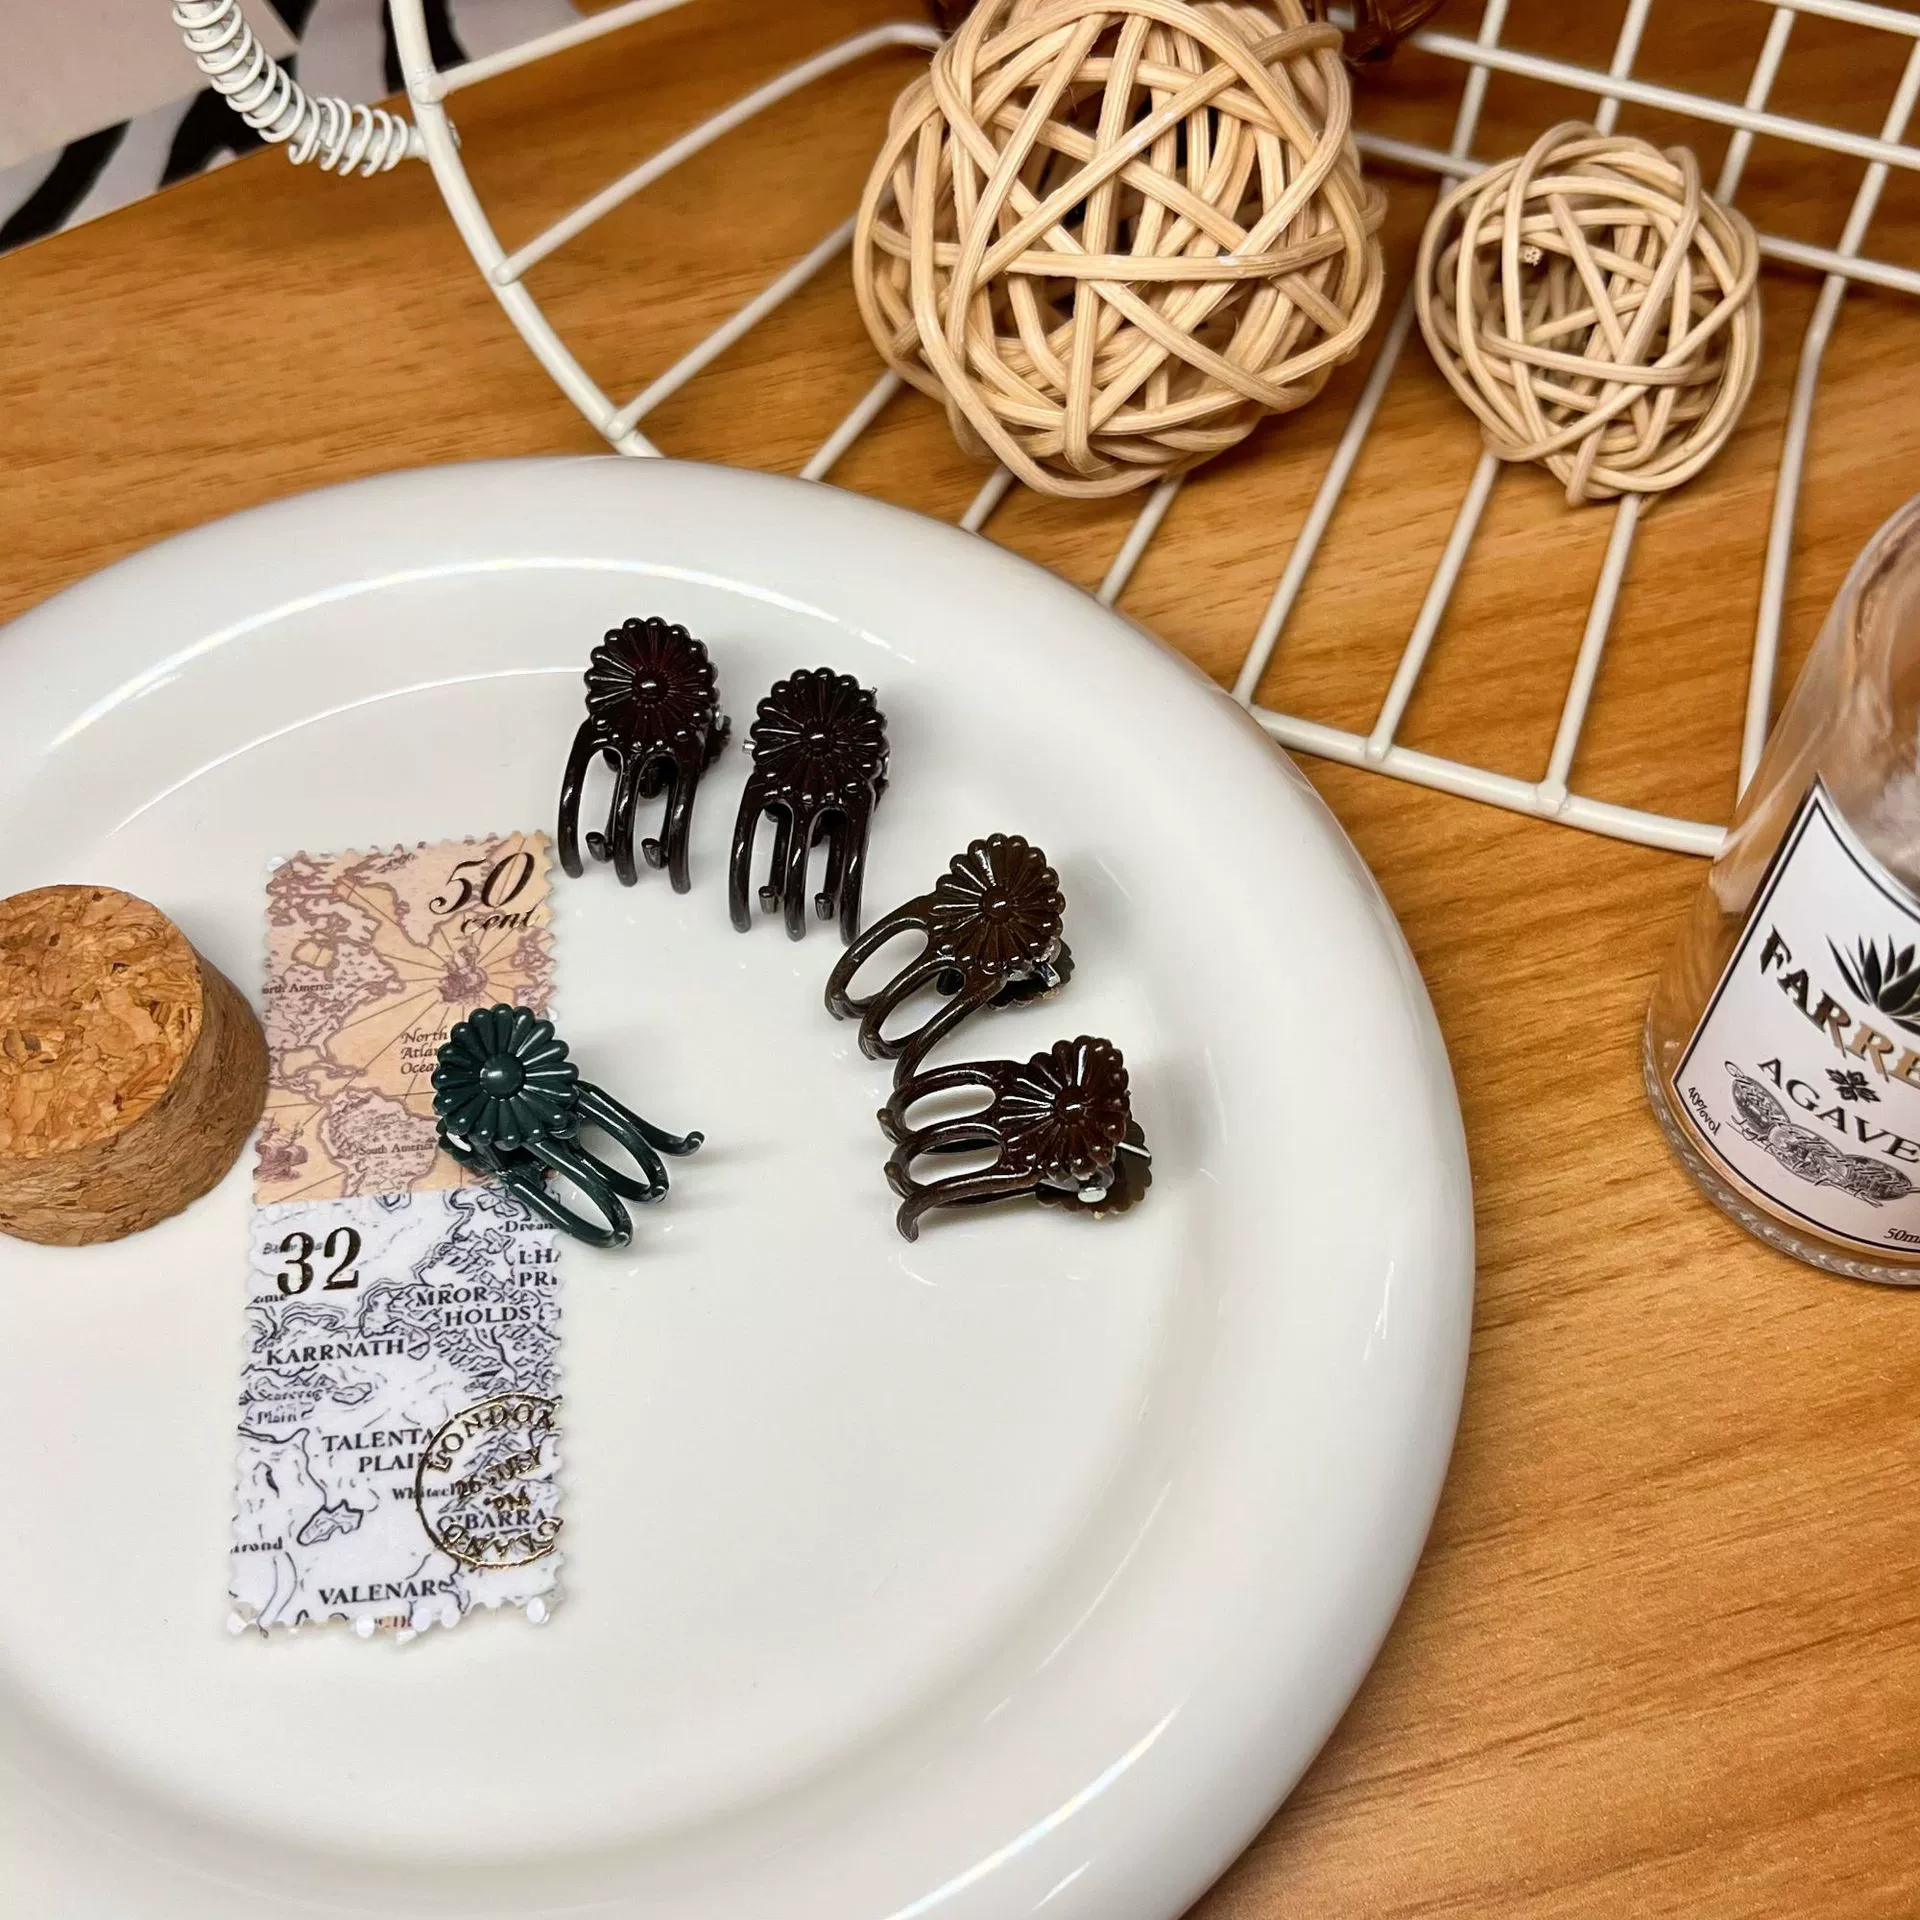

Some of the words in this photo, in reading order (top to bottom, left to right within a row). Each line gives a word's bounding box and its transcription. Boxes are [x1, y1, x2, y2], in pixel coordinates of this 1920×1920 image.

[429, 852, 535, 915] 50
[461, 897, 545, 935] cent
[289, 983, 334, 993] America
[400, 1026, 448, 1044] North
[1757, 1058, 1920, 1162] AGAVE
[391, 1143, 434, 1153] America
[276, 1226, 361, 1295] 32
[415, 1286, 488, 1307] MROR
[445, 1306, 531, 1327] HOLDS
[267, 1339, 404, 1366] KARRNATH
[321, 1428, 434, 1453] TALENTA
[318, 1580, 437, 1605] VALENAR
